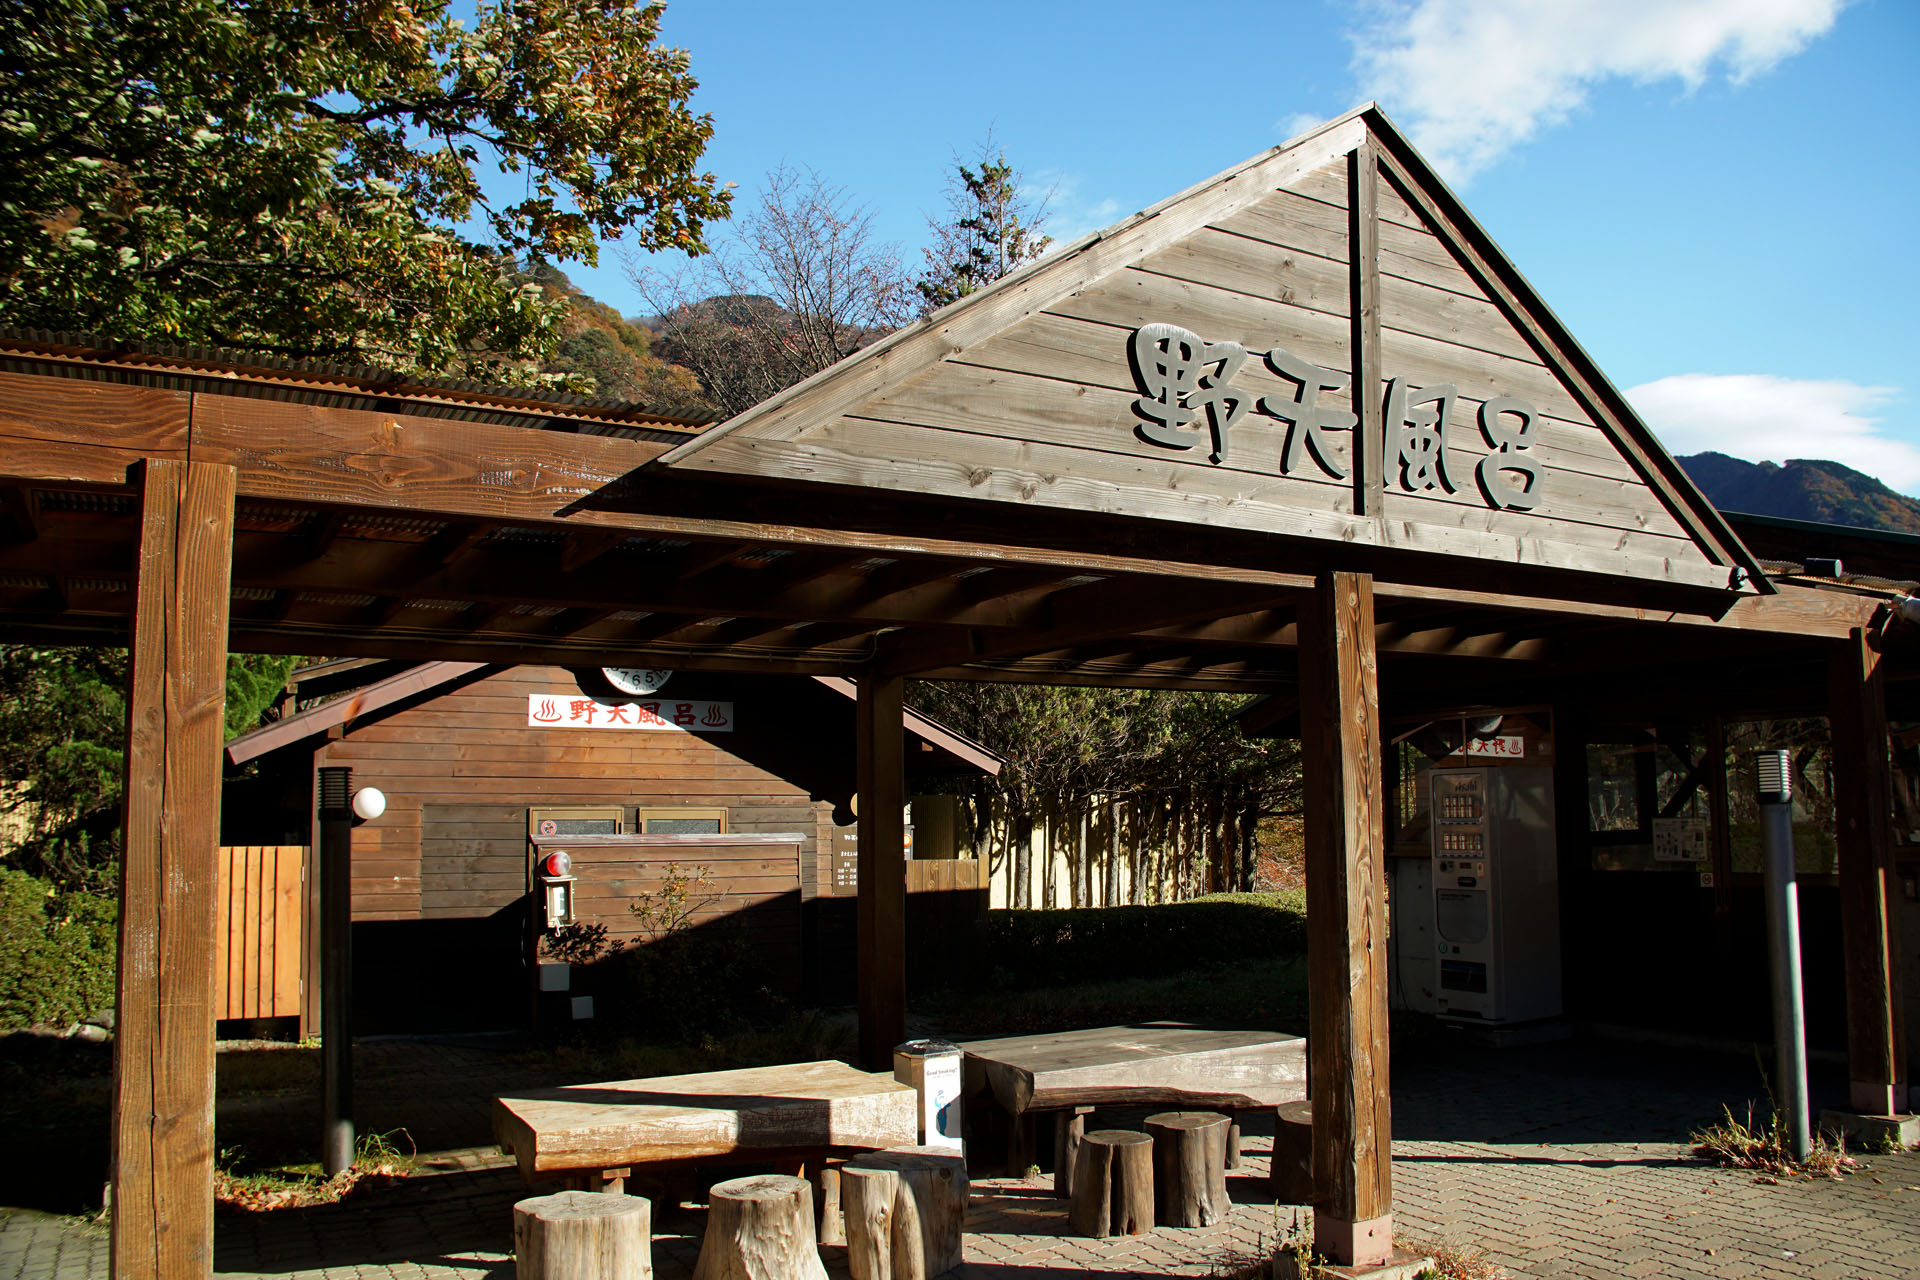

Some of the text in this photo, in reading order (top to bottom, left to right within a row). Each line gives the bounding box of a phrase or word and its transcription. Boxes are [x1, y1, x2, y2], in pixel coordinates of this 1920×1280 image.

[1128, 322, 1545, 511] 野天風呂
[620, 671, 654, 686] 7 6 5
[568, 699, 697, 726] 野天風呂
